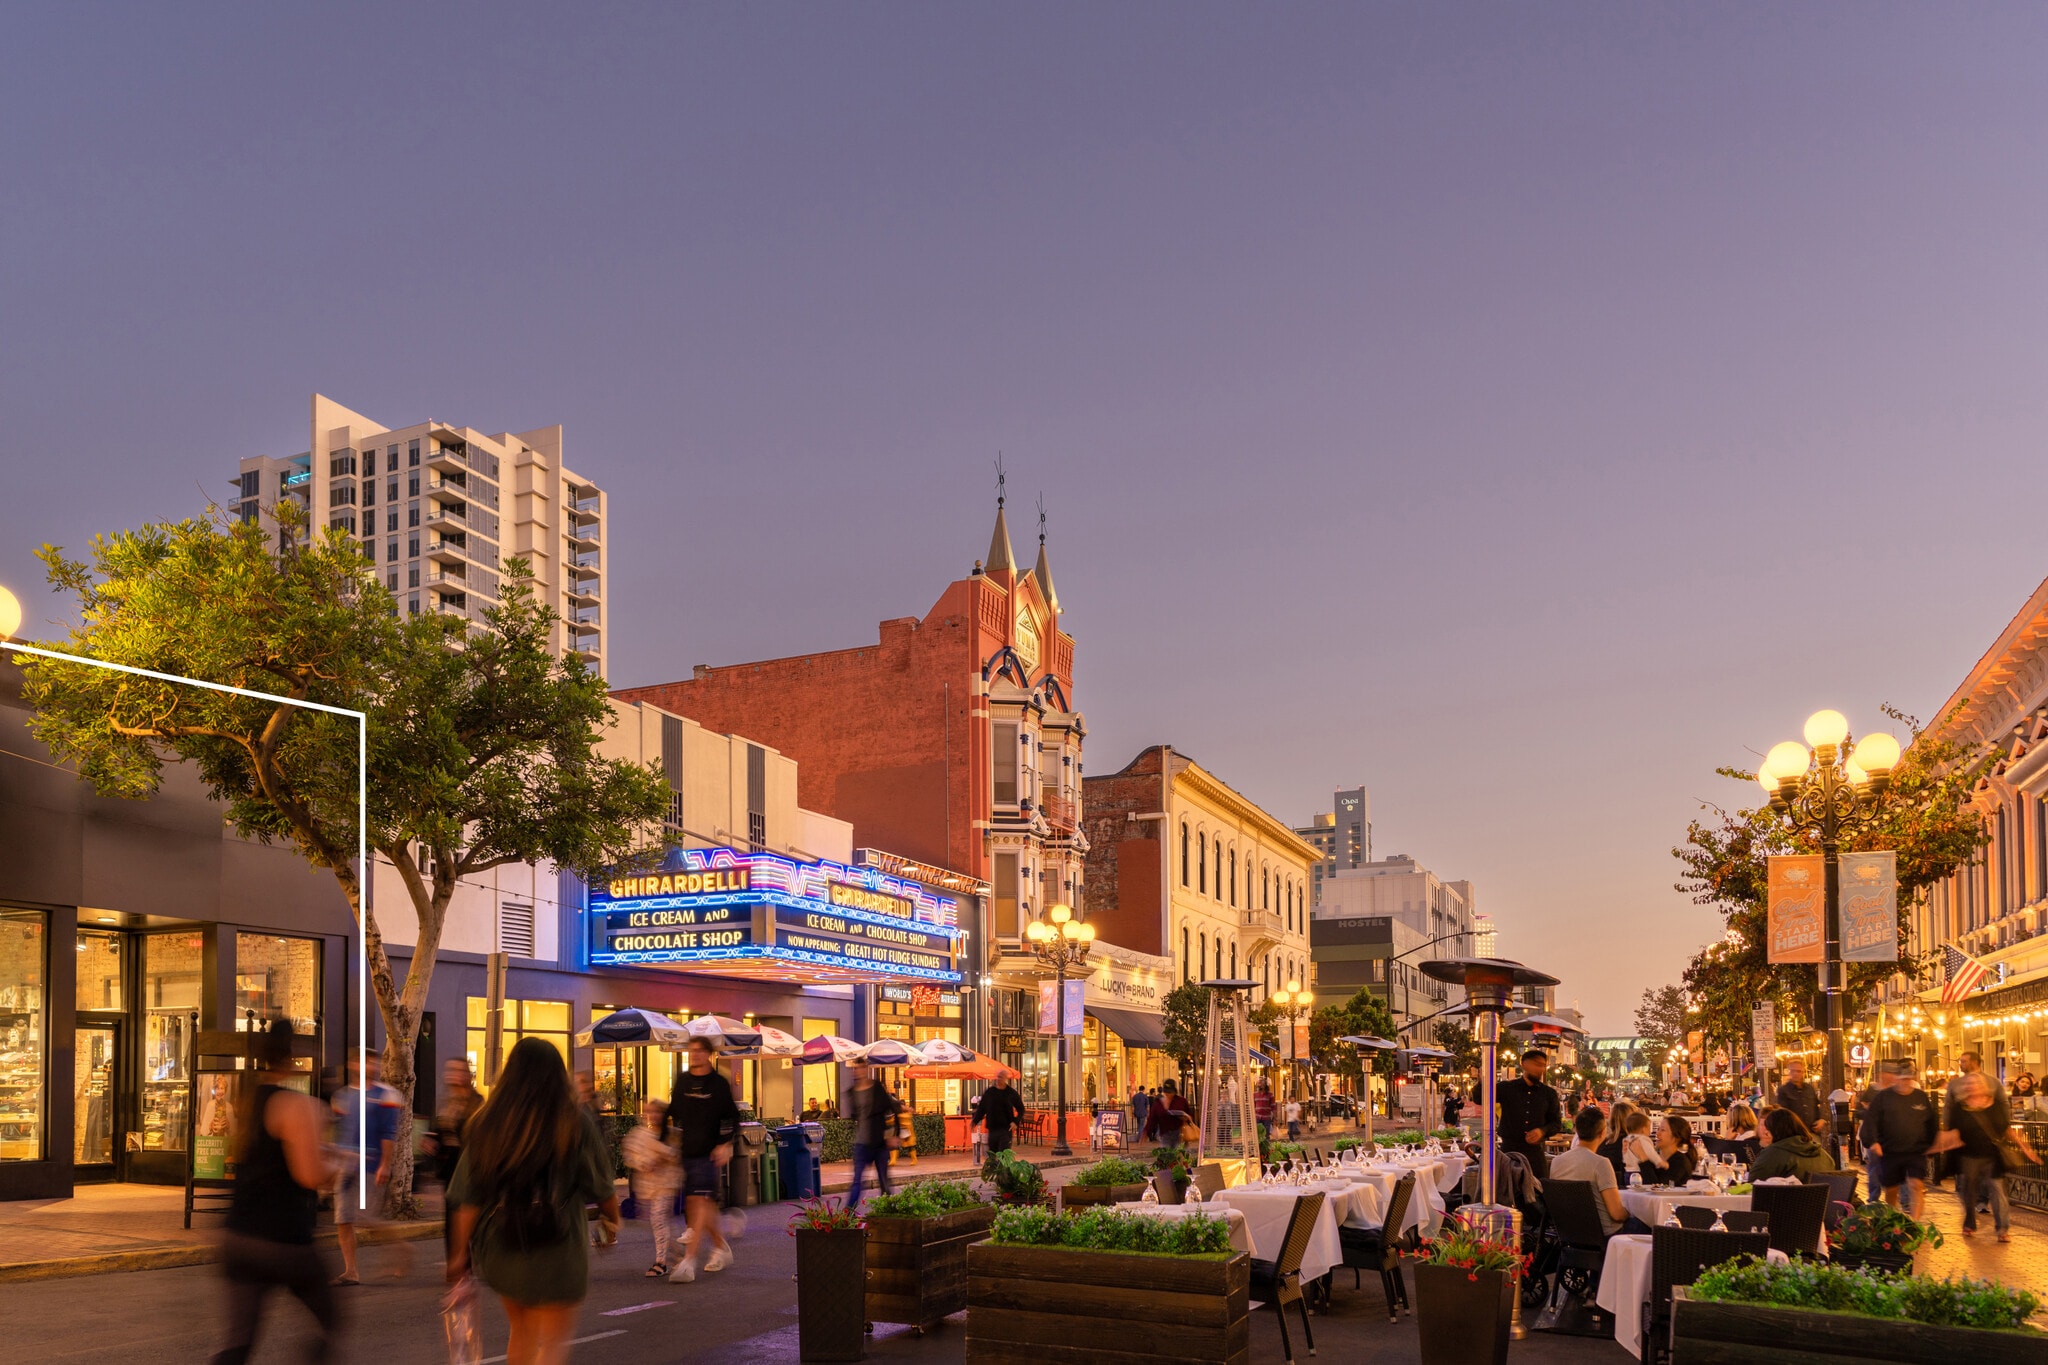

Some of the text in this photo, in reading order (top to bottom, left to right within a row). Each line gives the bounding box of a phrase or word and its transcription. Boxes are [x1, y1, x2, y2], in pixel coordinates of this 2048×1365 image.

[609, 870, 748, 898] GHIRARDELLI
[832, 885, 912, 919] GHIRARDELLI
[629, 908, 729, 927] ICE CREAM AND
[1338, 919, 1385, 928] HOSTEL
[807, 913, 927, 946] ICE CREAM AND CHOCOLATE SHOP
[1776, 922, 1819, 938] START
[1848, 920, 1890, 937] START
[614, 931, 742, 951] CHOCOLATE SHOP
[1775, 930, 1819, 951] HERE
[1847, 928, 1892, 950] HERE
[787, 935, 940, 969] NOW APPEARING: GREAT! HOT FUDGE SUNDAES
[884, 987, 912, 1000] WORLD'S
[940, 994, 960, 1004] BURGER
[1103, 979, 1155, 998] LUCKY BRAND
[196, 1139, 224, 1147] CELEBRITY
[196, 1147, 224, 1156] FREE SINCE
